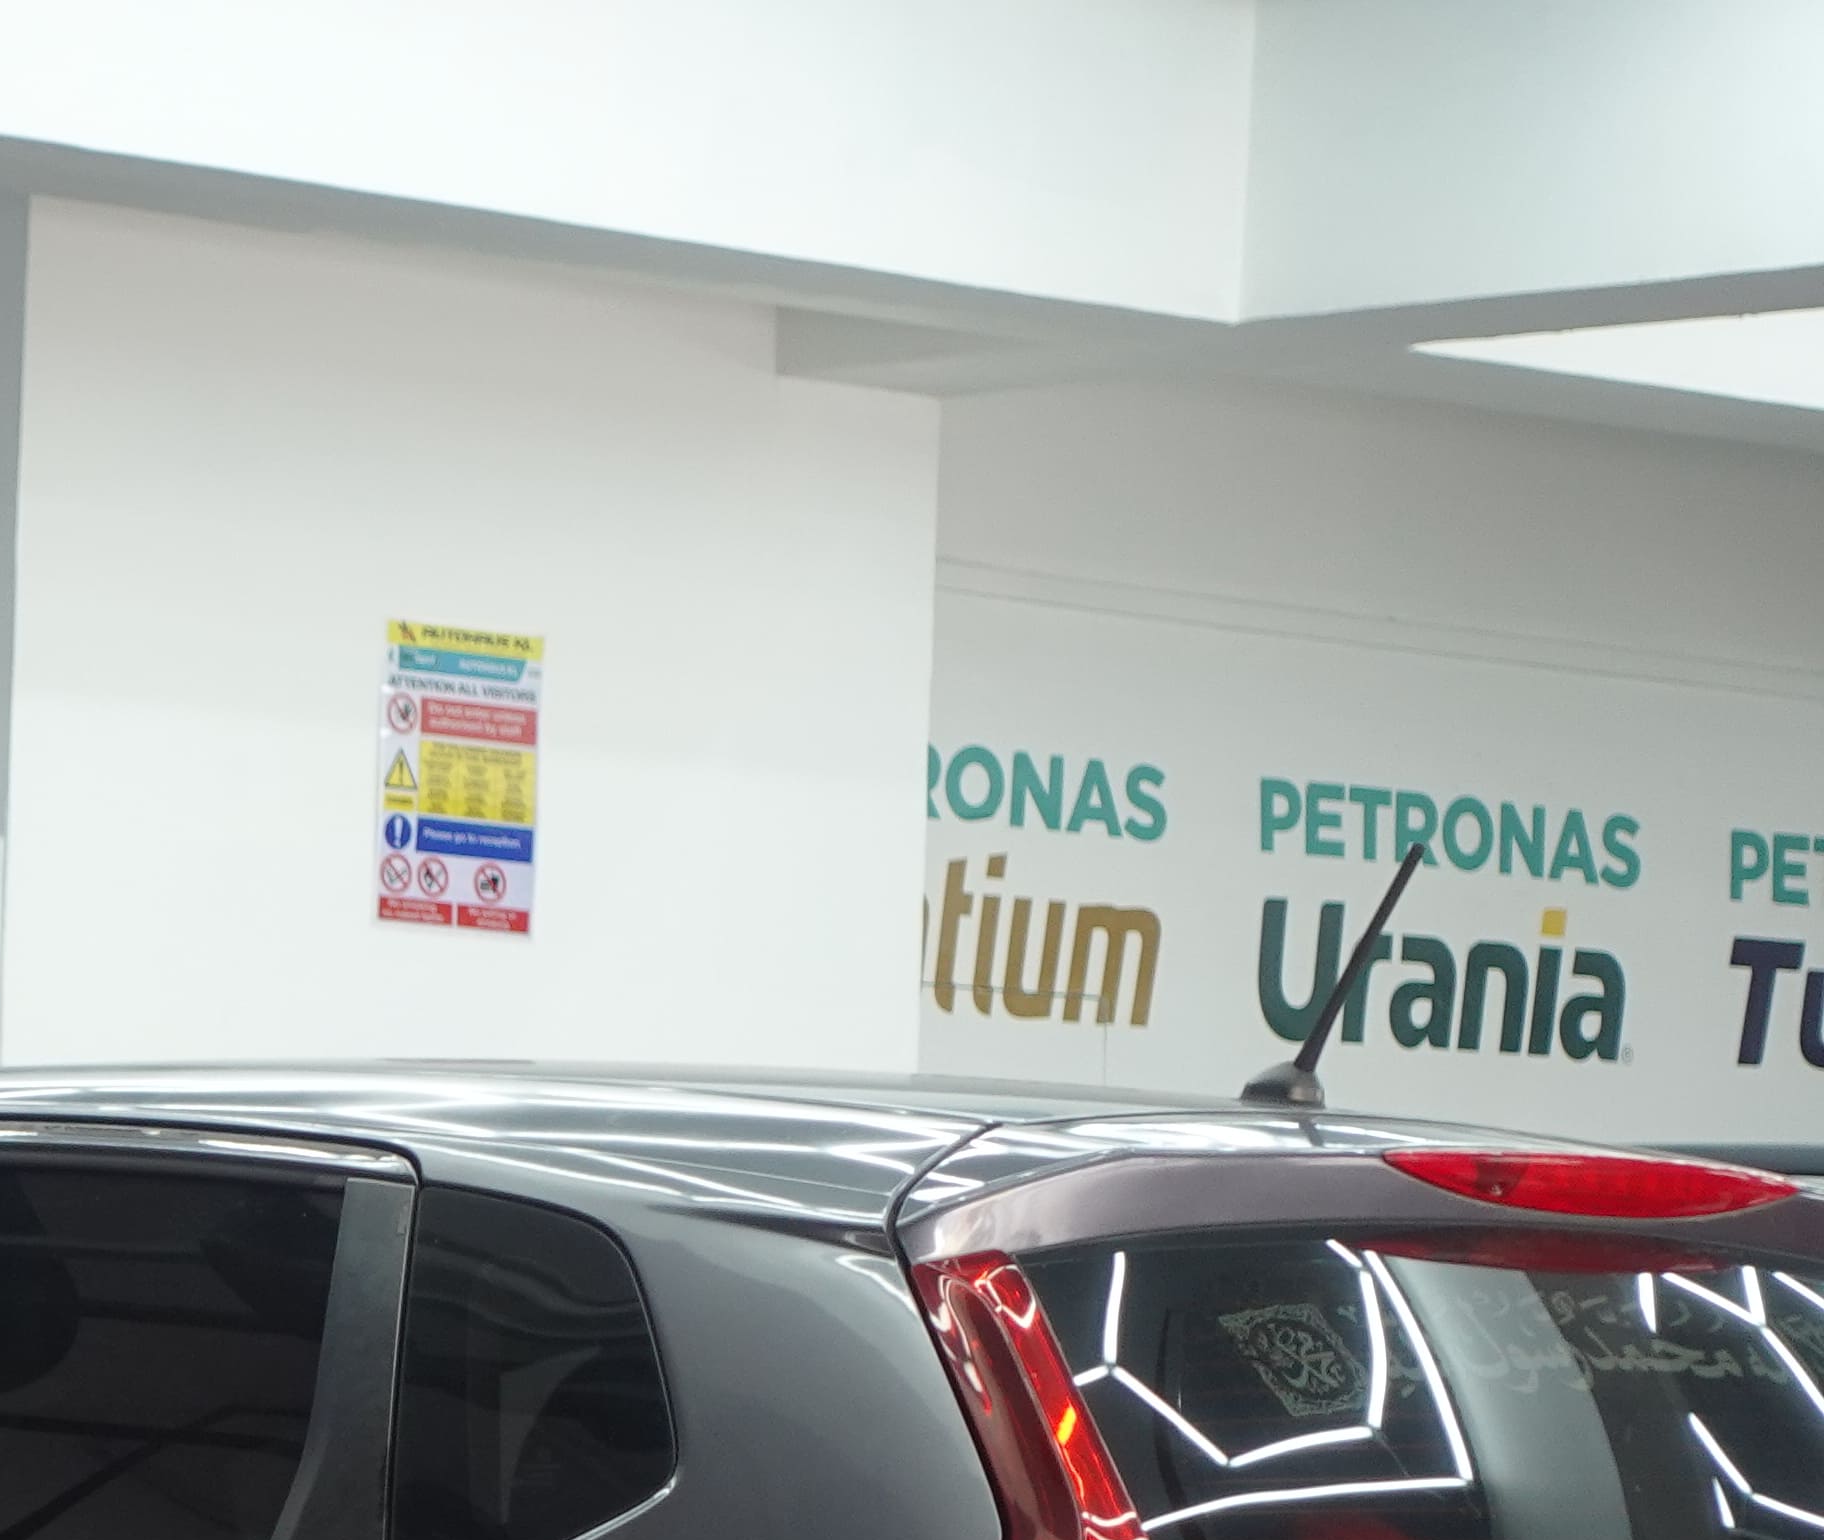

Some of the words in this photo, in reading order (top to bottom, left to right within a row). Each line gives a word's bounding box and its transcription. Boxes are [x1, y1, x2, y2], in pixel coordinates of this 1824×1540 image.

[927, 742, 1168, 841] ONAS
[1259, 776, 1642, 889] PETRONAS
[1729, 829, 1824, 906] PE
[922, 852, 1162, 1027] tium
[1258, 897, 1628, 1063] Urania
